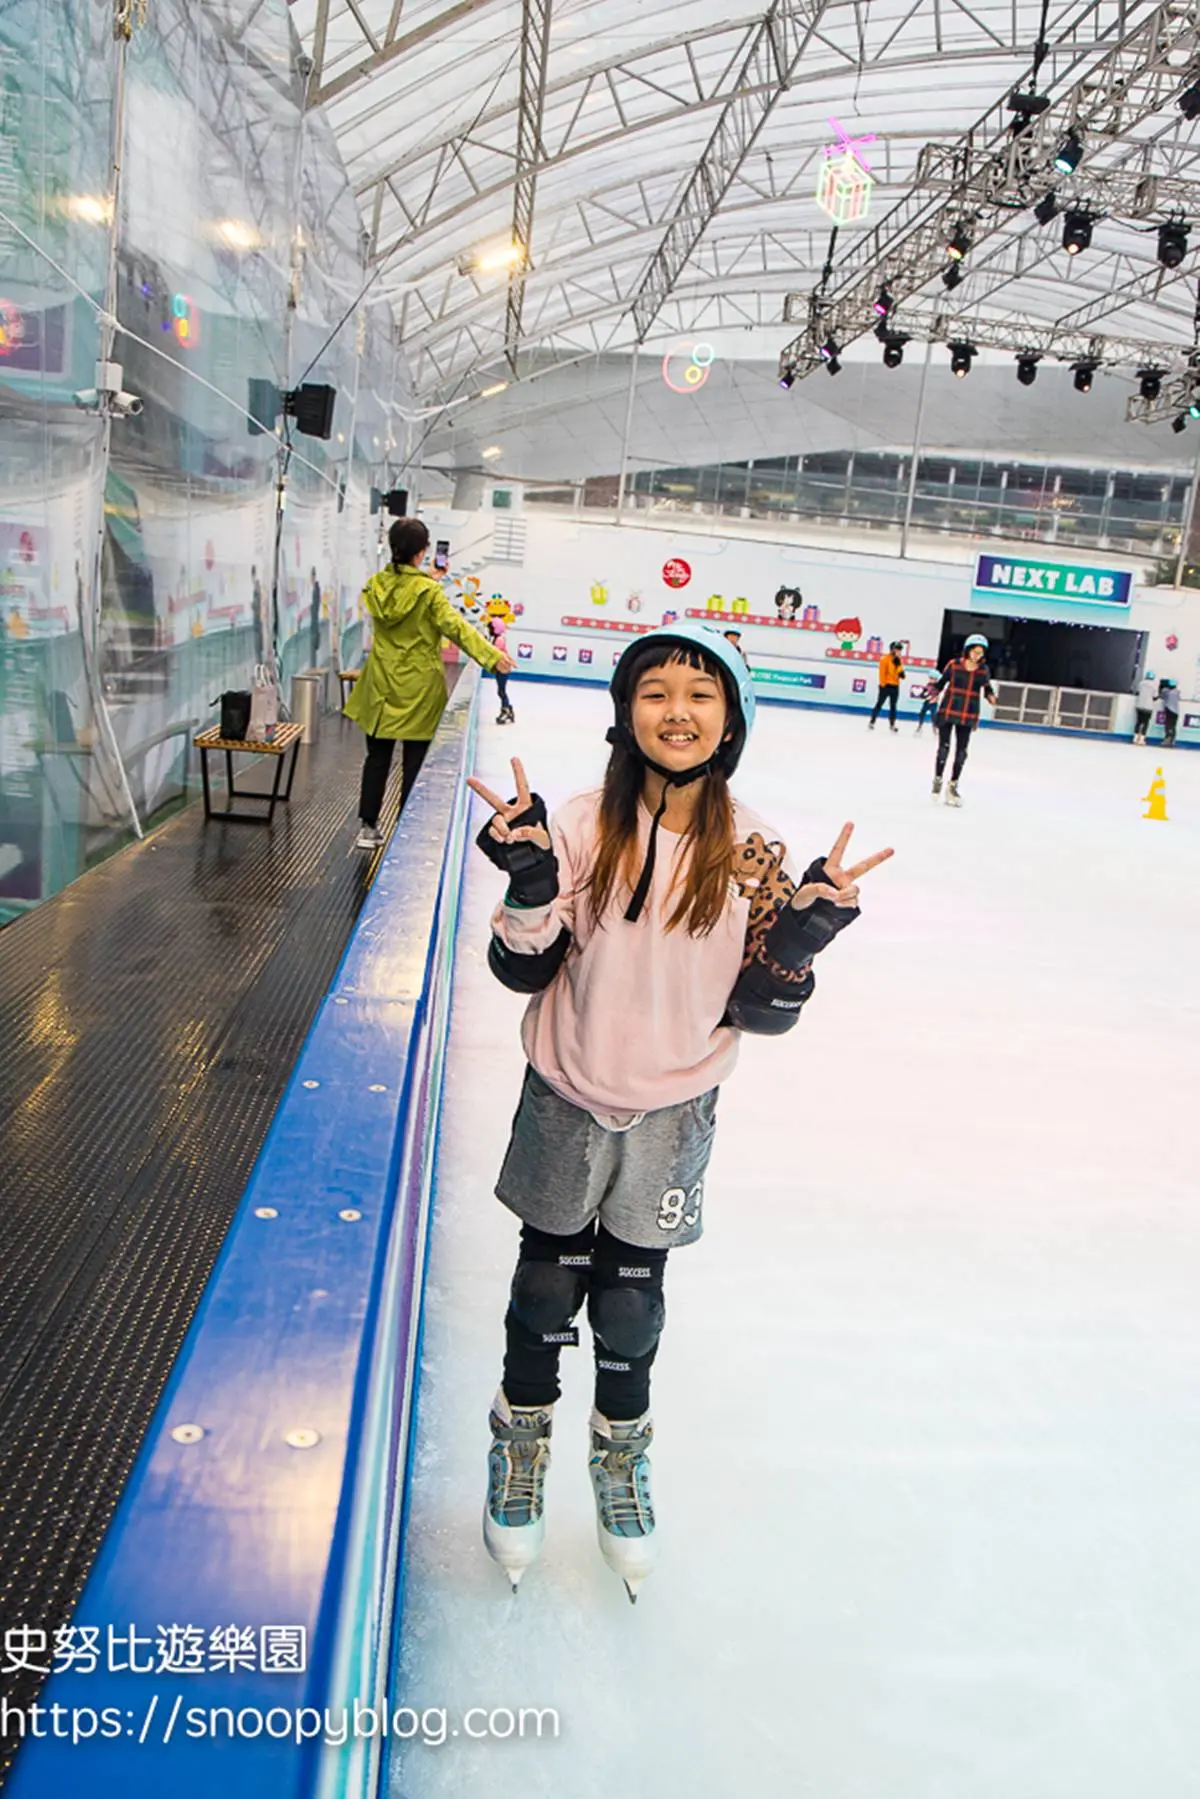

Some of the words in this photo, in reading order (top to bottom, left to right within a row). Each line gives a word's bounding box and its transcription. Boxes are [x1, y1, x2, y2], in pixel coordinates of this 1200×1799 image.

[991, 564, 1060, 590] NEXT
[1064, 573, 1114, 596] LAB
[558, 1255, 592, 1265] SUCCESS
[618, 1266, 652, 1278] SUCCESS
